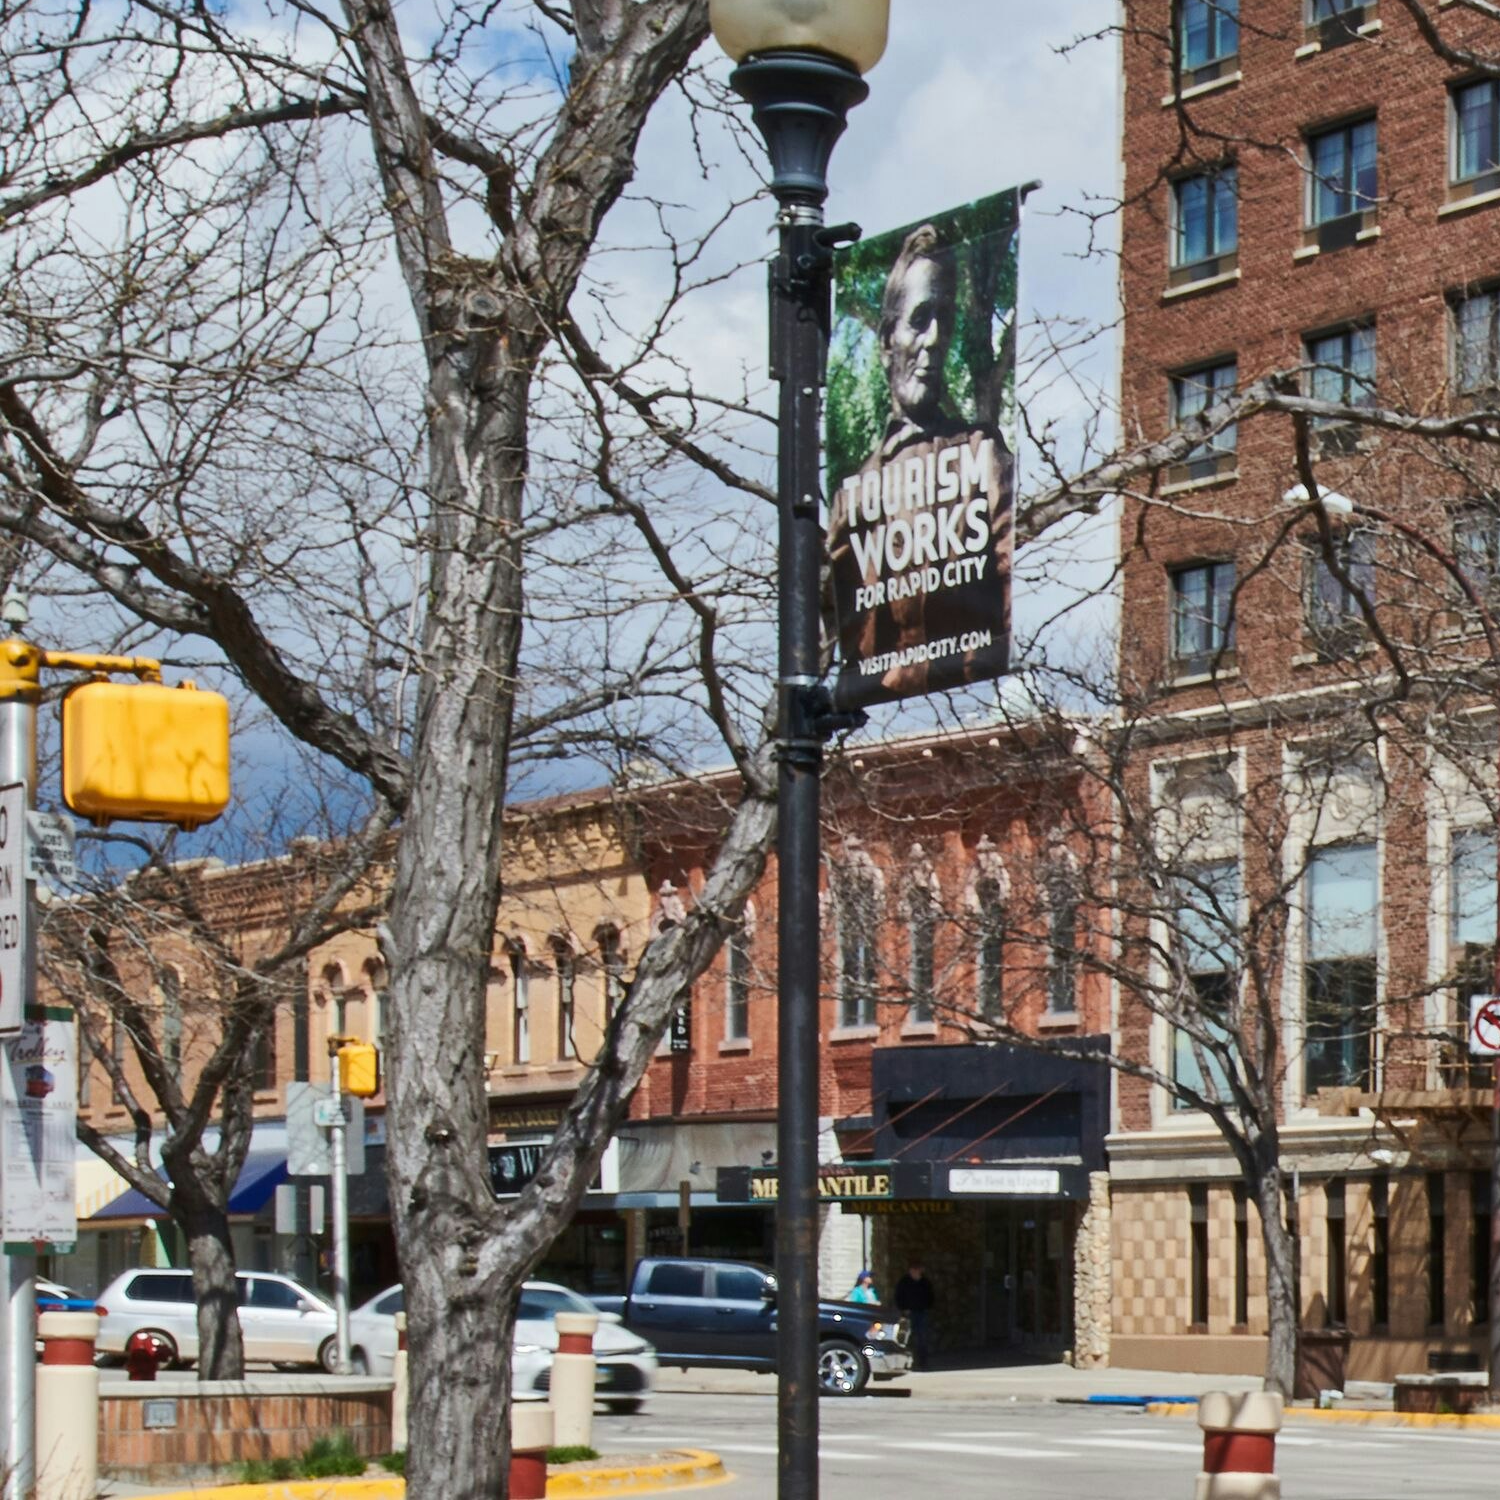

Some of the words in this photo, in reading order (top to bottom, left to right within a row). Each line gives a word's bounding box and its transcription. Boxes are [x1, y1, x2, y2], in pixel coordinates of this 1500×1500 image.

[843, 438, 993, 527] TOURISM
[850, 498, 989, 581] WORKS
[855, 581, 885, 612] FOR
[887, 567, 940, 602] RAPID
[943, 555, 988, 587] CITY
[858, 629, 991, 675] VISITRAPIDCITY.COM
[752, 1174, 889, 1198] MEANTILE
